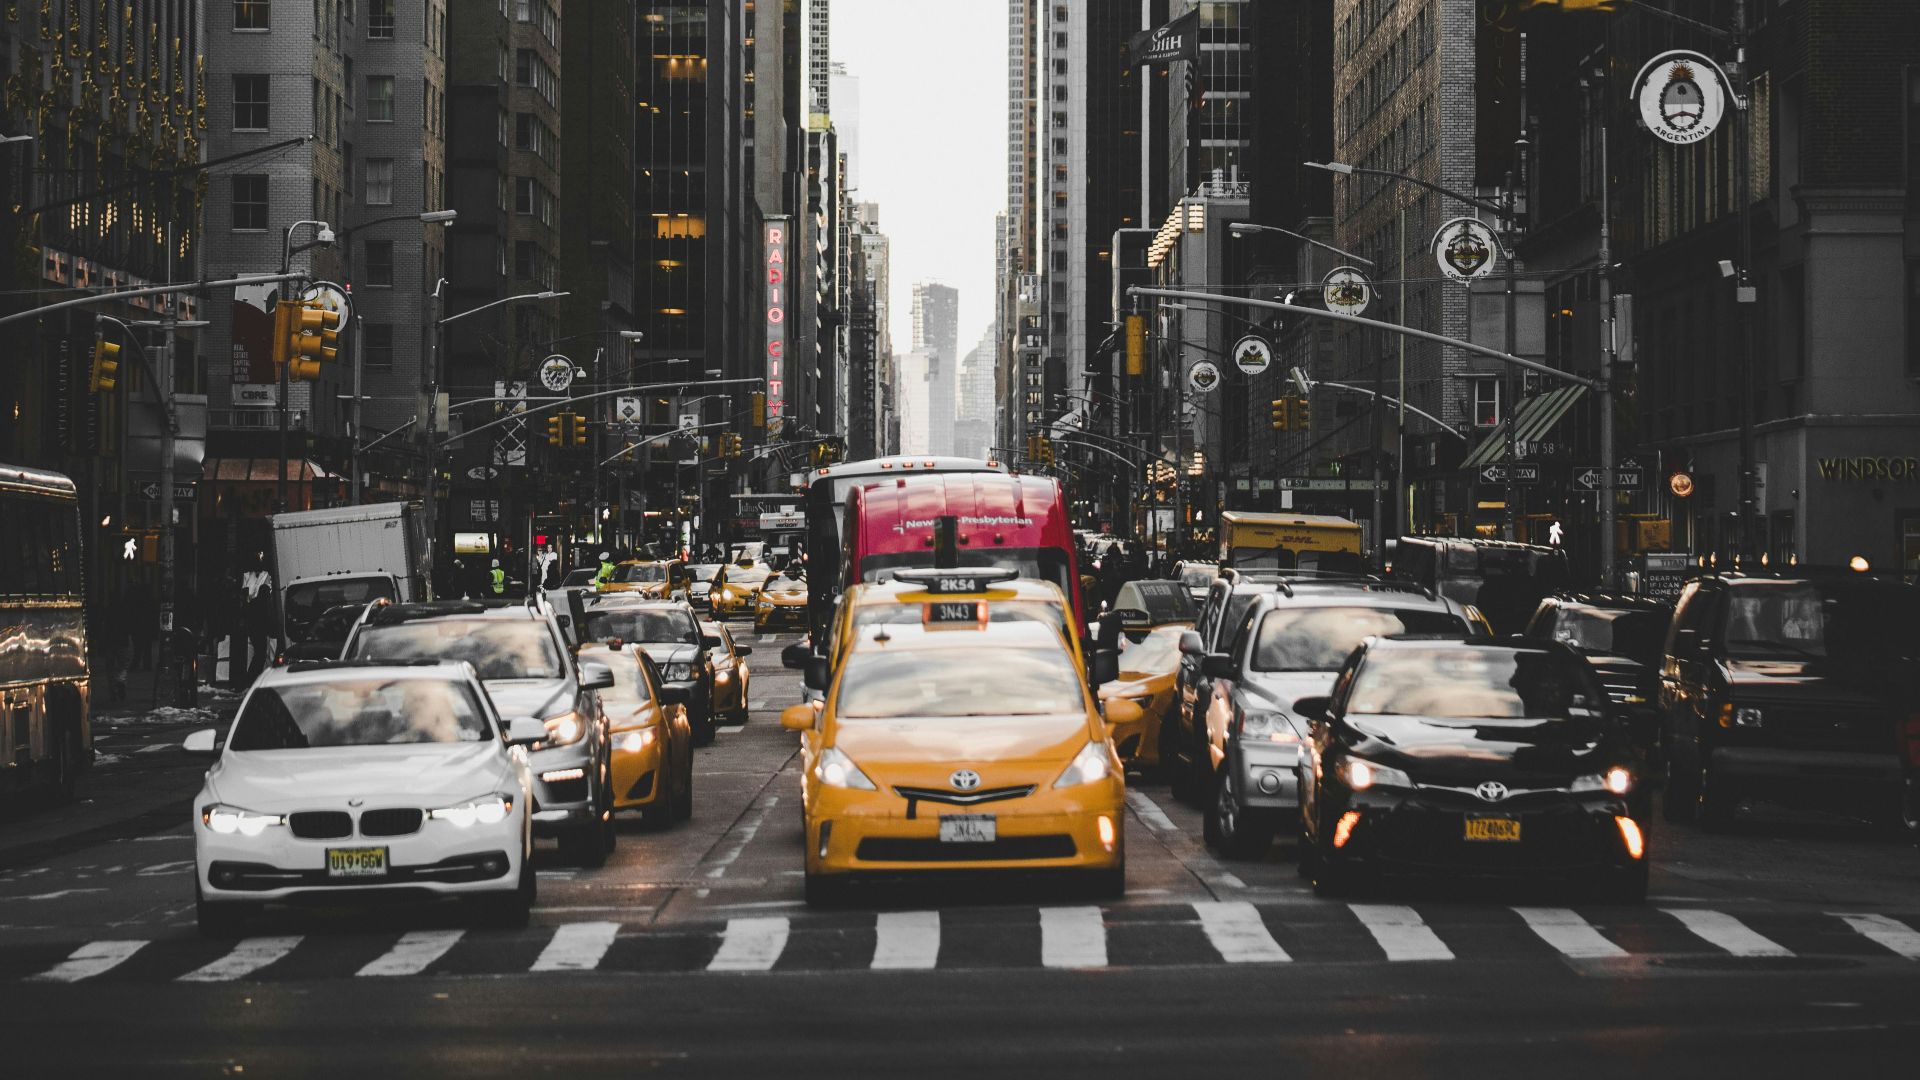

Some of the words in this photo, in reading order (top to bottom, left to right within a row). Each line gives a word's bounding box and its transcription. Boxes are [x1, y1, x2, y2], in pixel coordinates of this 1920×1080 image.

[1654, 125, 1711, 142] ARGENTINA
[768, 228, 784, 323] RADIO
[768, 341, 784, 416] CITY
[241, 391, 268, 400] CBRE
[1543, 442, 1554, 454] 58
[1816, 455, 1920, 481] WINDSOR
[1661, 559, 1686, 568] TITAN
[940, 604, 969, 620] 3N43
